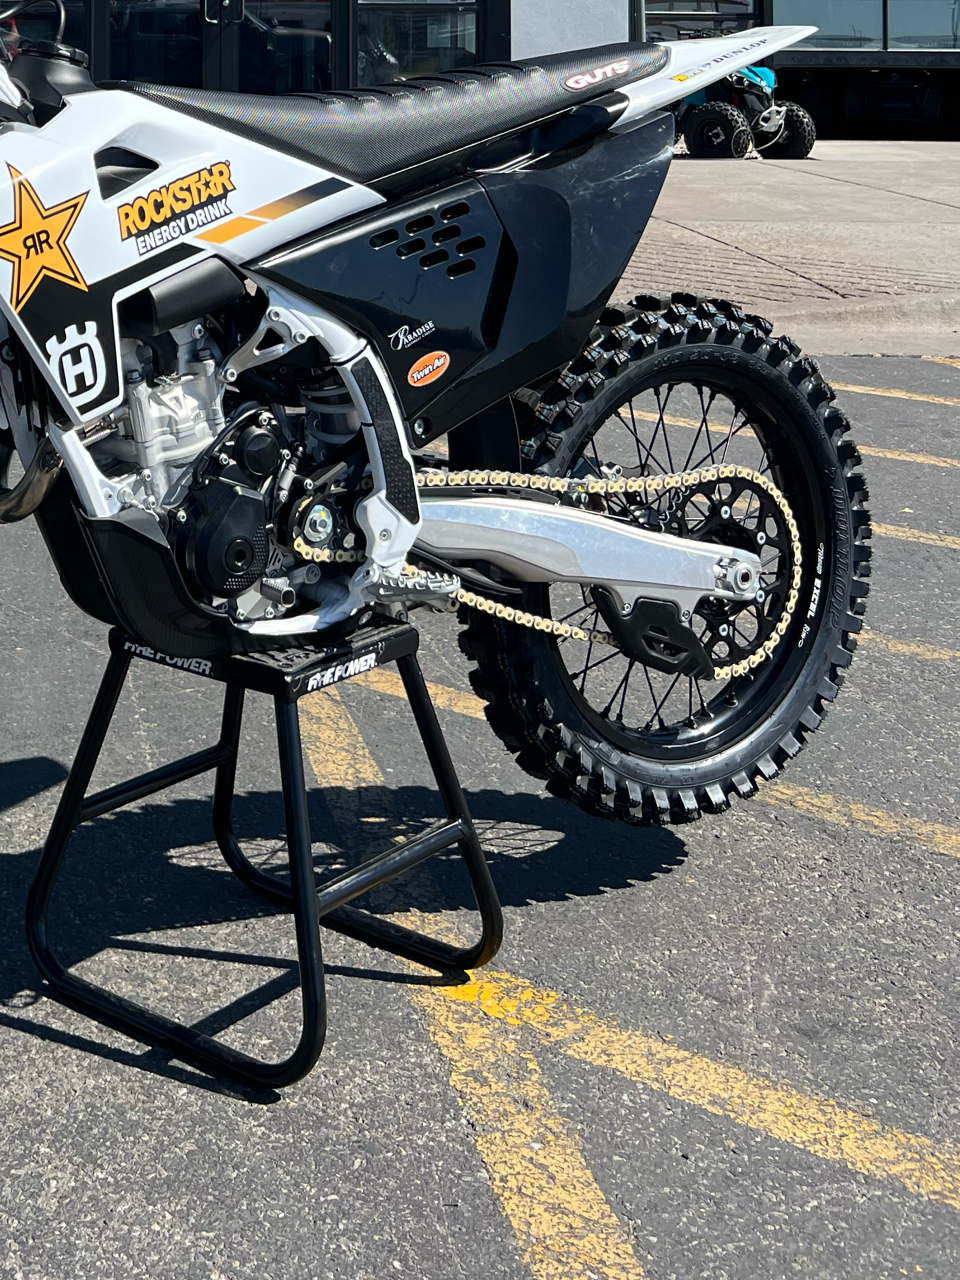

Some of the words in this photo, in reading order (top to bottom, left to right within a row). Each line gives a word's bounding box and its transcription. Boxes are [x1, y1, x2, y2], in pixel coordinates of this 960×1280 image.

[712, 39, 769, 64] DUNLOP
[564, 58, 630, 91] GUTS
[118, 161, 237, 241] ROCKSTAR
[138, 216, 188, 256] ENERGY
[187, 197, 233, 232] DRINK
[411, 364, 433, 383] Twin
[433, 354, 447, 370] Air
[807, 578, 821, 619] EXCEL
[334, 653, 376, 682] POWER
